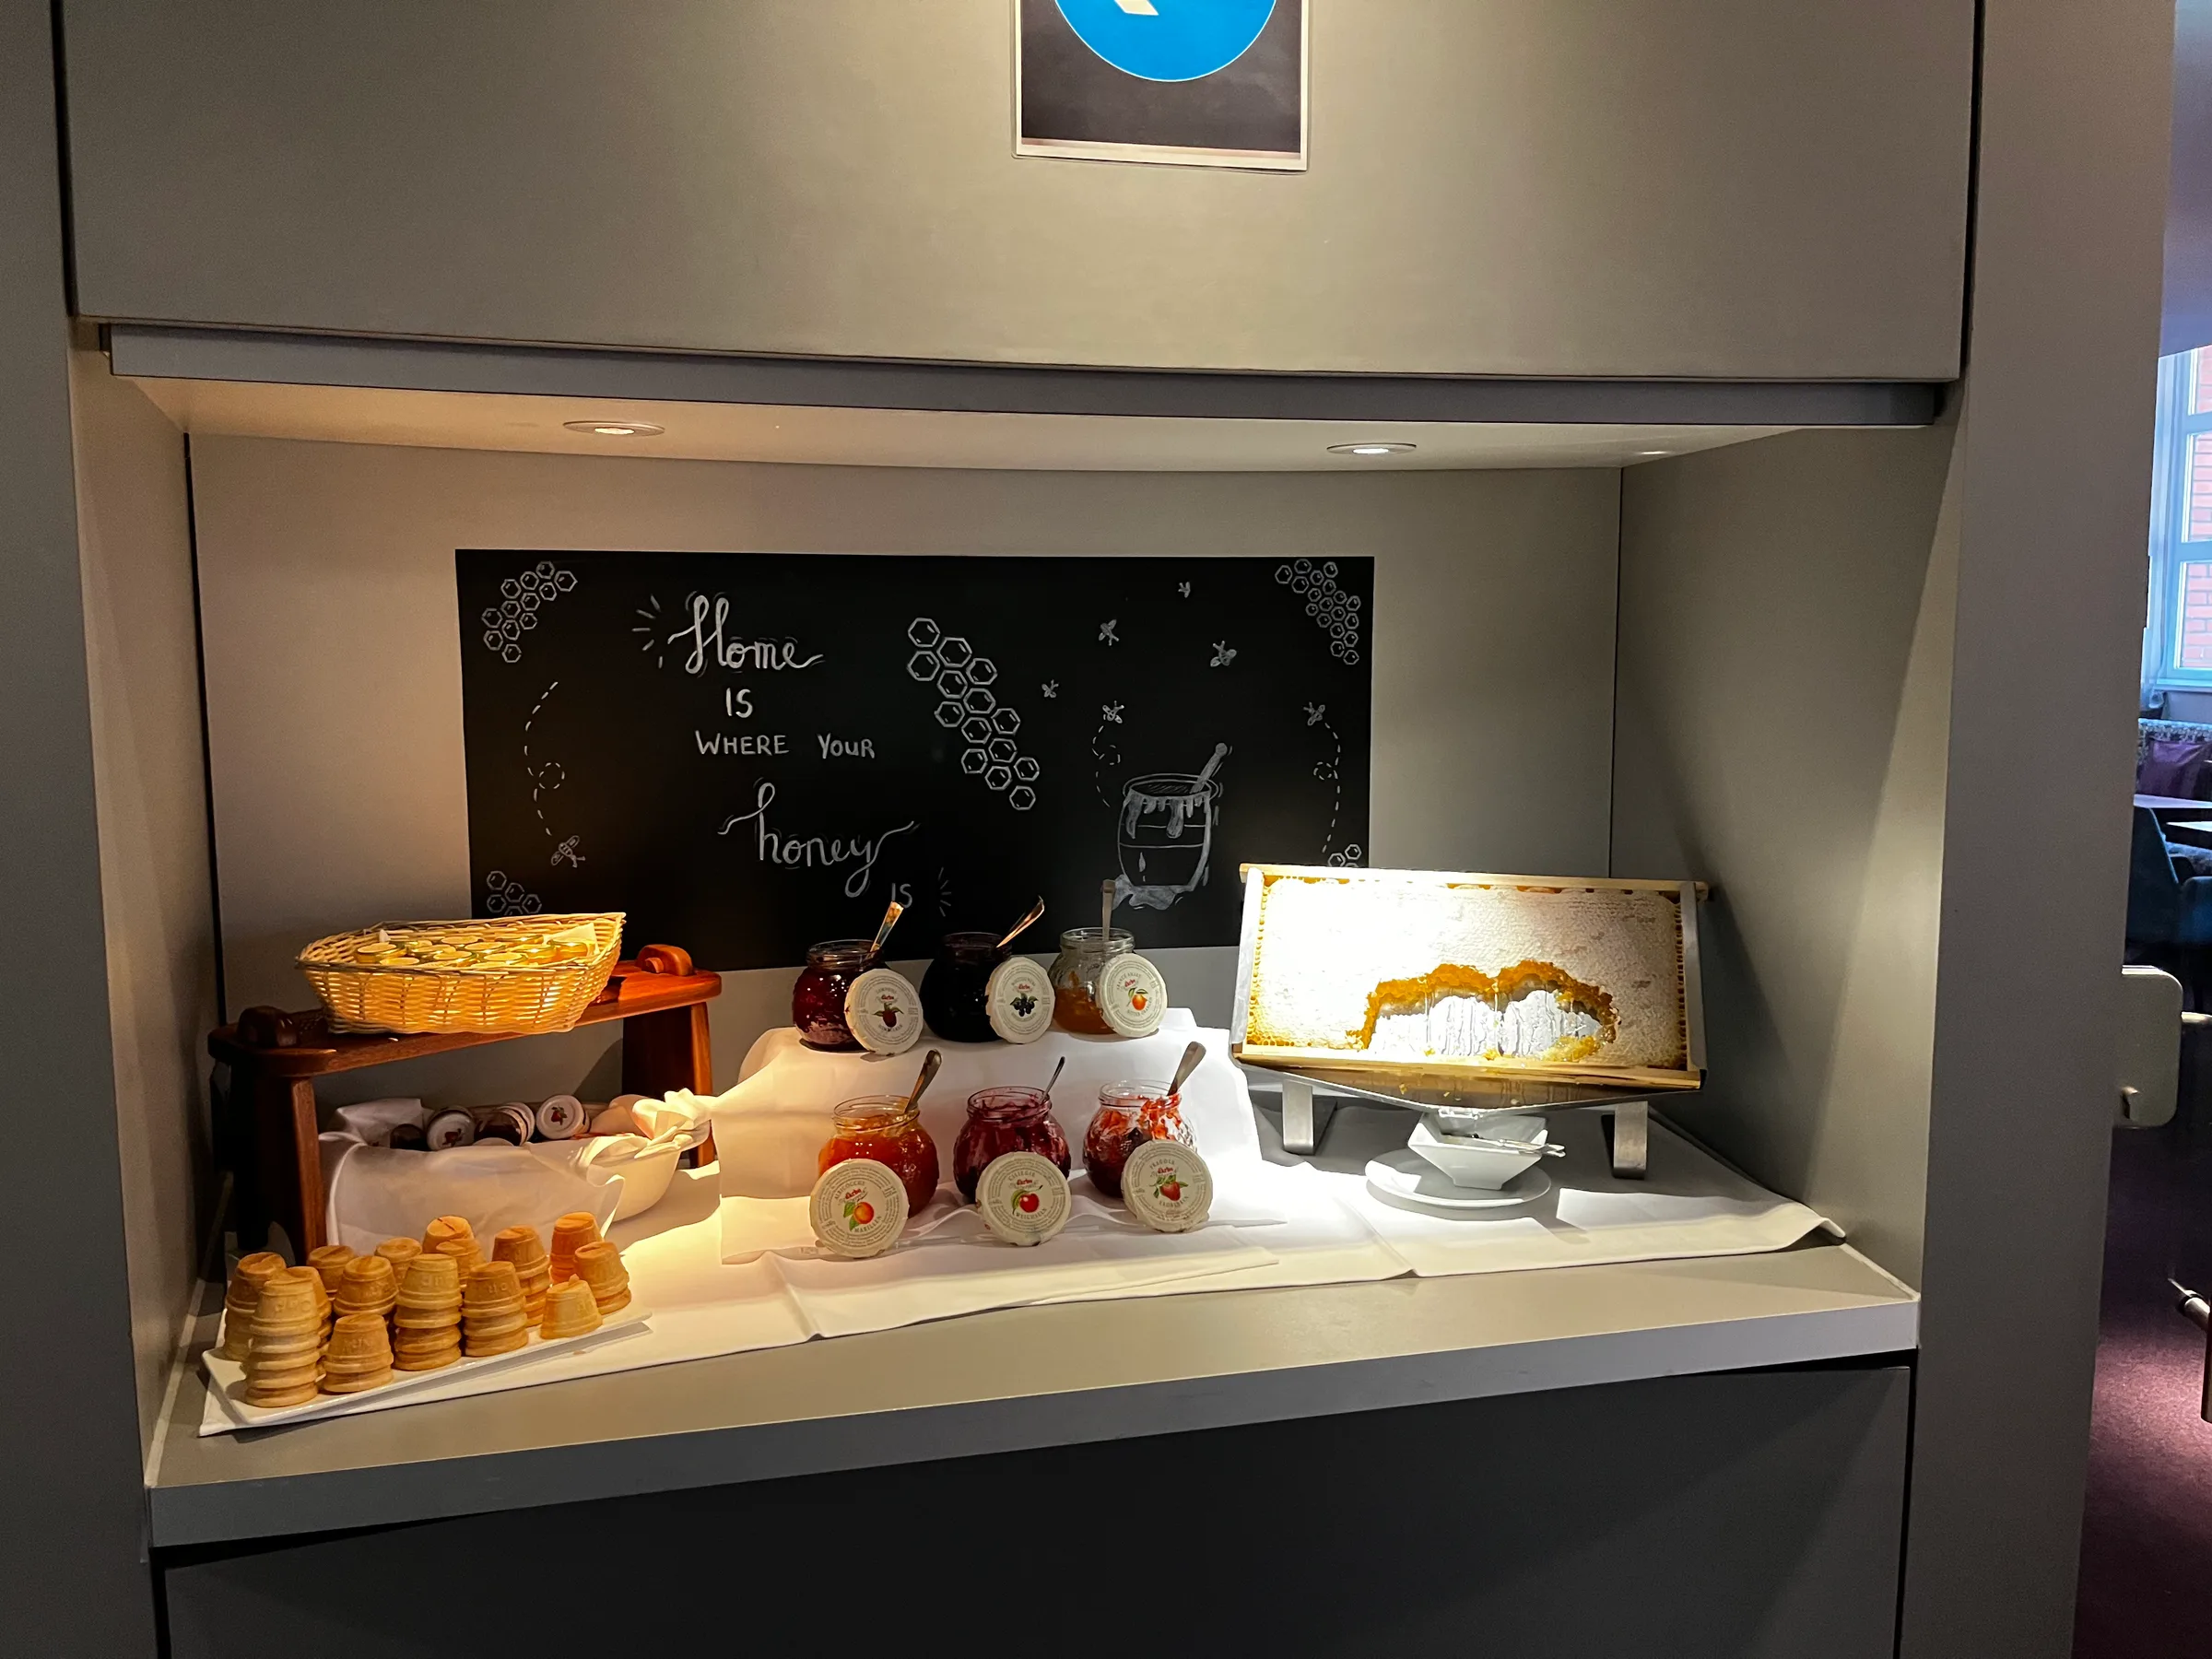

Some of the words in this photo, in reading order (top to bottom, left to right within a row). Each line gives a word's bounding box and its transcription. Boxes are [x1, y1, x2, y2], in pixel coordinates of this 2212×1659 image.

[667, 594, 823, 675] Home
[725, 688, 753, 718] IS
[695, 730, 790, 756] WHERE
[718, 782, 915, 898] honey
